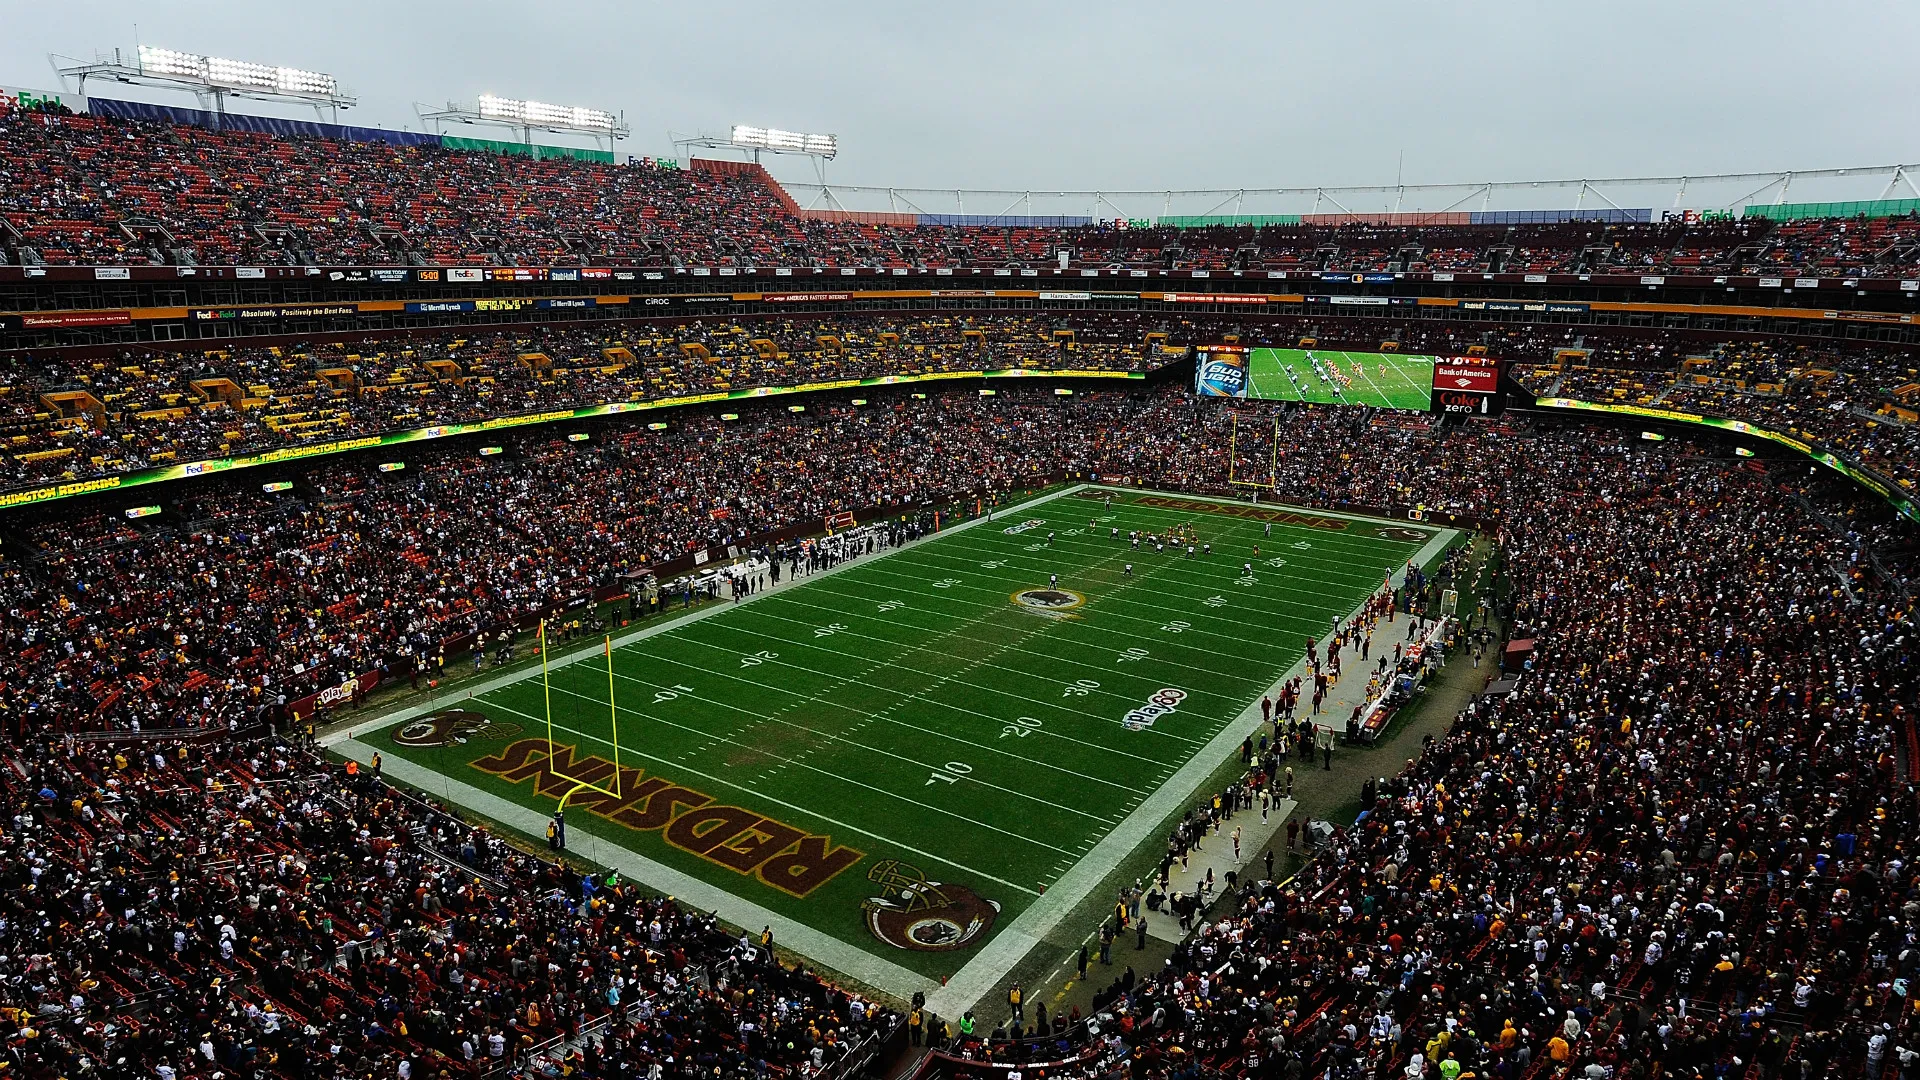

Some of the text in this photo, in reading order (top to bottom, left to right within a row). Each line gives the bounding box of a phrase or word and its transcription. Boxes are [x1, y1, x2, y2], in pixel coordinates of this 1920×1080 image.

[1100, 218, 1149, 228] FedExField
[420, 271, 438, 279] 15:00
[454, 270, 474, 278] FedEx
[551, 270, 577, 280] StubHub!
[196, 310, 236, 320] FedExField
[281, 308, 312, 317] Positively
[446, 303, 461, 311] Lynch
[24, 317, 62, 325] Budweiser
[1208, 365, 1242, 379] BUD
[1438, 367, 1455, 375] Bank
[1462, 369, 1491, 378] America
[1440, 391, 1480, 407] Coke
[1445, 404, 1473, 414] zero
[186, 458, 233, 475] FedExField
[261, 452, 280, 463] THE
[281, 442, 337, 460] WASHINGTON
[58, 476, 121, 497] REDSKINS
[1133, 495, 1352, 531] REDSKINS
[1162, 619, 1191, 634] 50
[741, 650, 780, 667] 20
[1120, 647, 1150, 663] 40
[652, 682, 695, 704] 10
[1073, 679, 1101, 698] 30
[1014, 716, 1043, 739] 20
[931, 761, 973, 786] 10
[467, 738, 867, 899] REDSKINS
